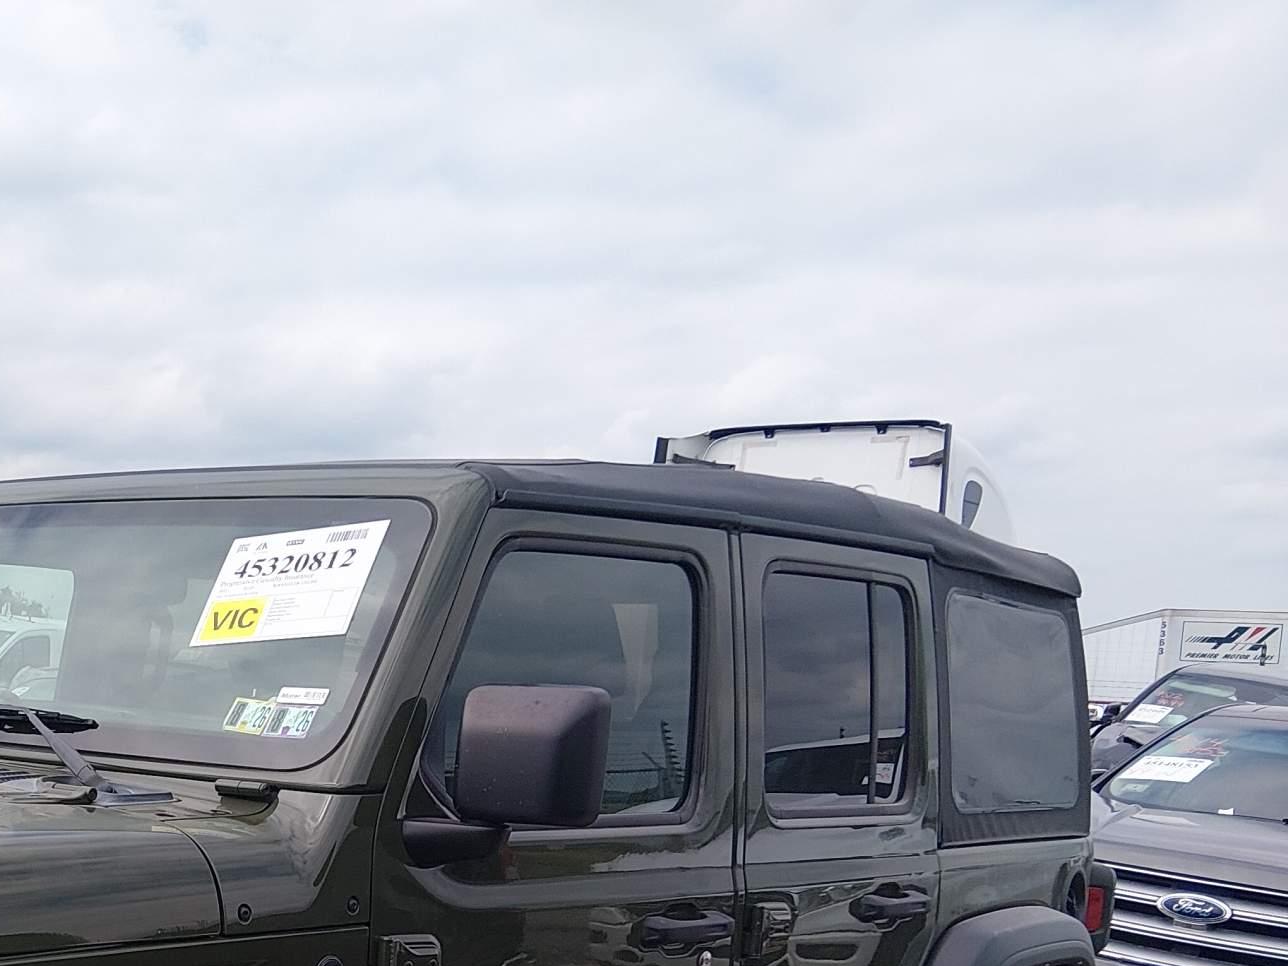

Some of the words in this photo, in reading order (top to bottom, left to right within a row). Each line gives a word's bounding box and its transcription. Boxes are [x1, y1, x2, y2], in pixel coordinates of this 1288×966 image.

[234, 548, 357, 579] 45320812
[213, 607, 259, 631] VIC
[1173, 898, 1214, 917] Ford
